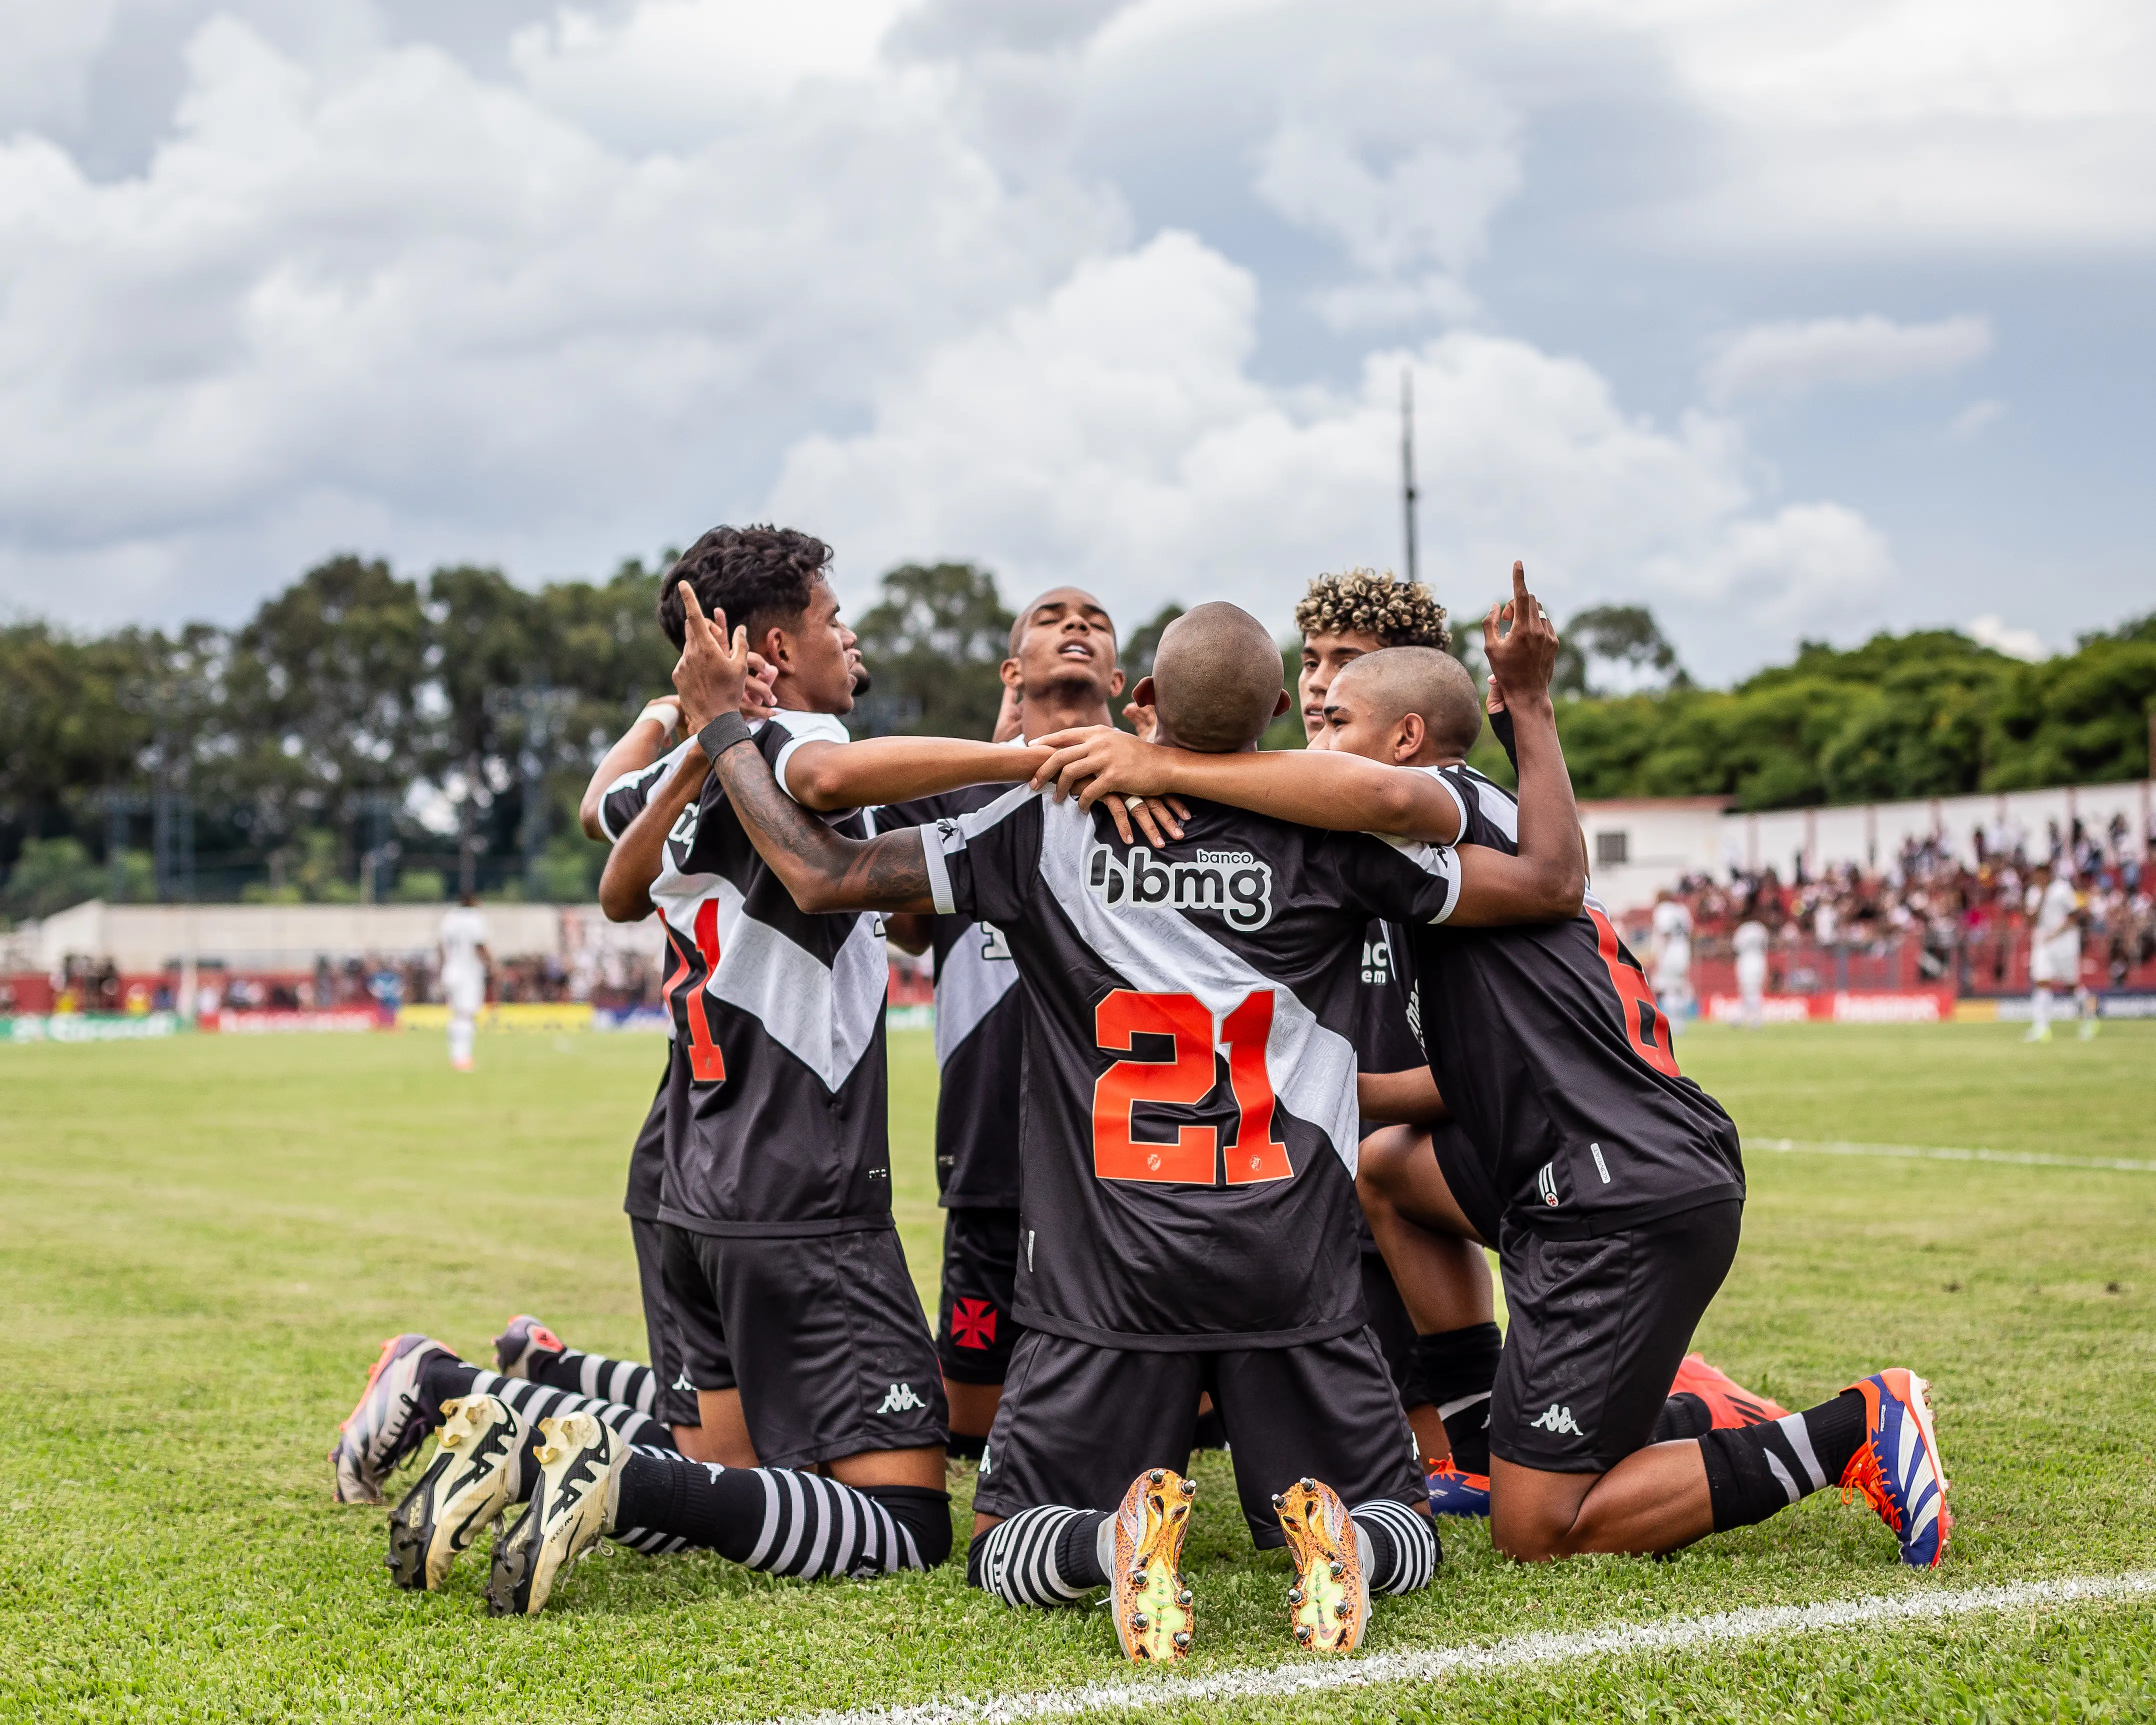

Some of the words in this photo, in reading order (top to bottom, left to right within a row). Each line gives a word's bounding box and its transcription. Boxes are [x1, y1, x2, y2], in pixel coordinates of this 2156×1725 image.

[1198, 850, 1252, 864] banco
[1132, 852, 1266, 926] bmg
[1092, 988, 1294, 1186] 21
[1594, 1148, 1608, 1180] KOMBAT
